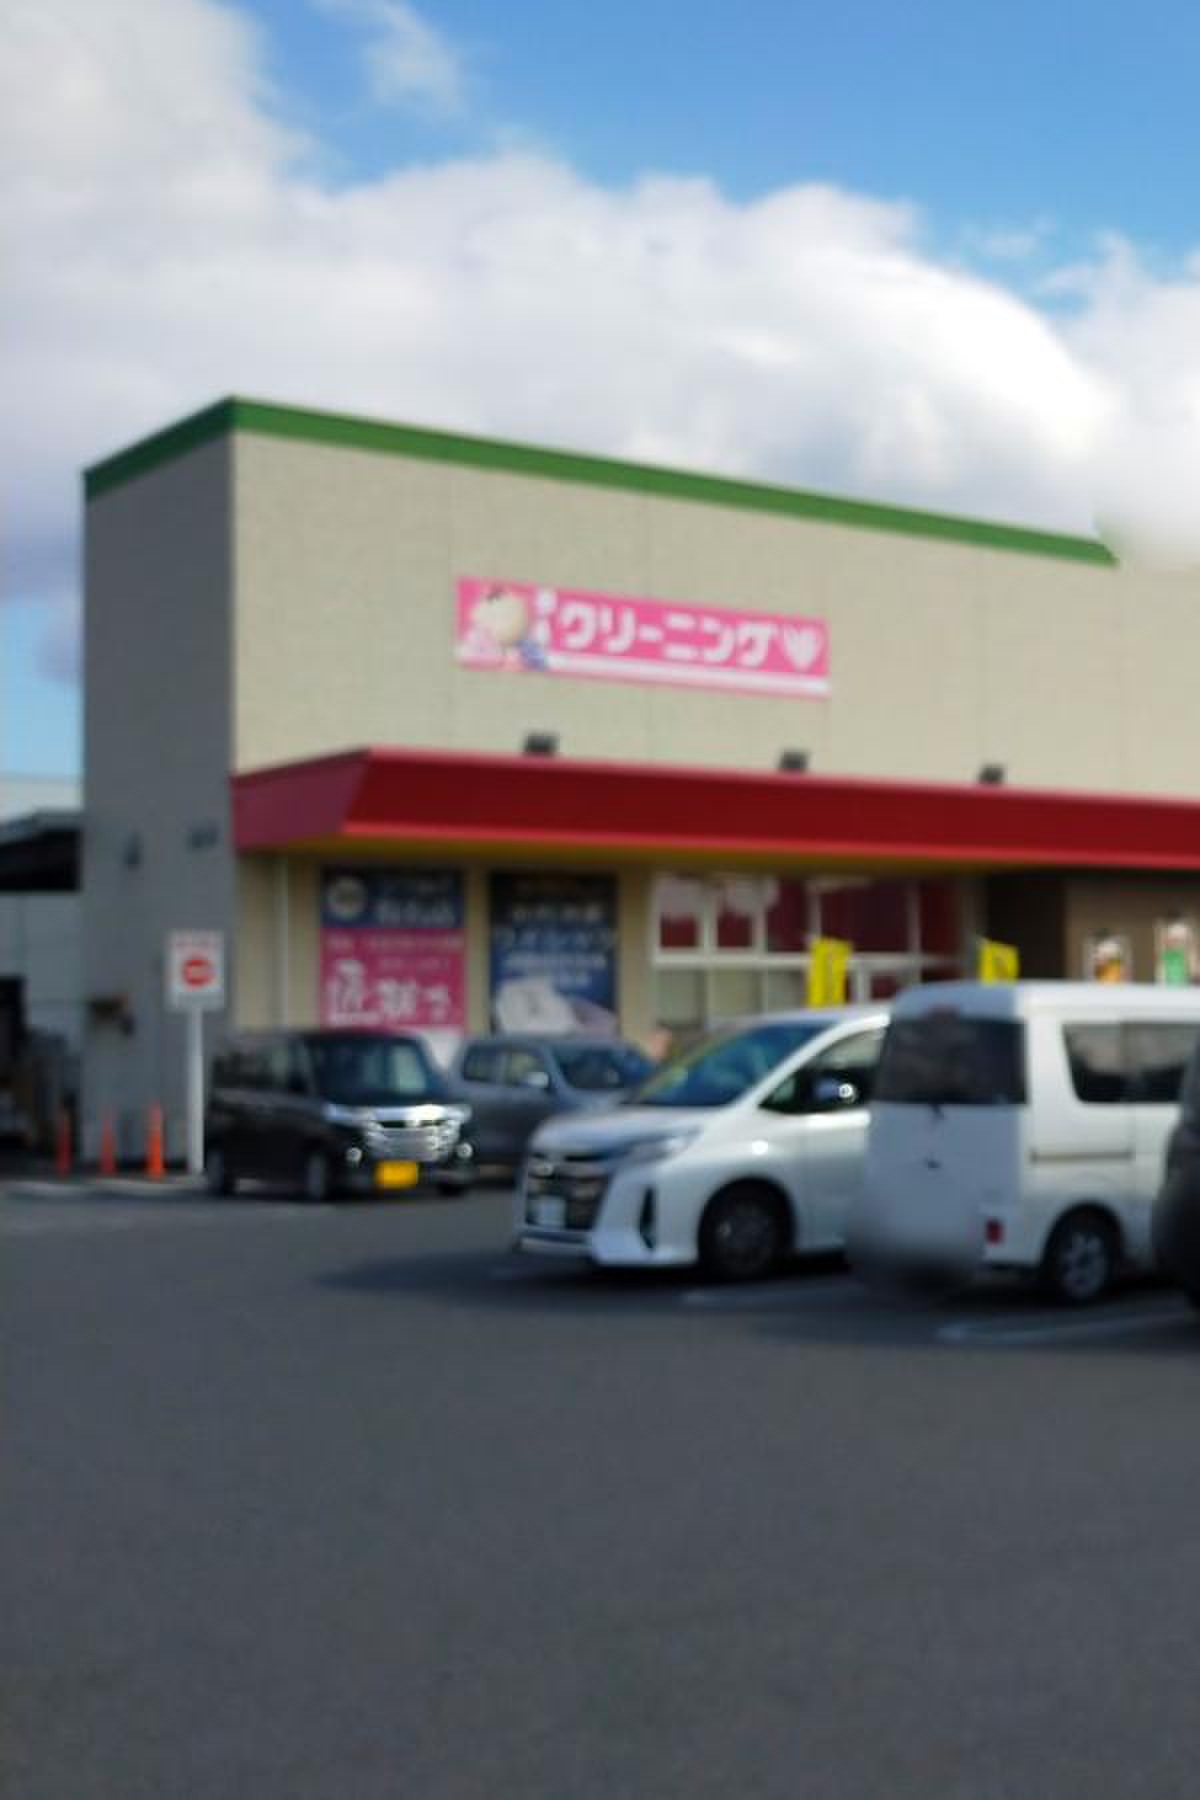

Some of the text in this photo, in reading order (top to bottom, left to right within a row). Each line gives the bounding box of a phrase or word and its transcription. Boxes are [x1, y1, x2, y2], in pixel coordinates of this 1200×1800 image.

[558, 602, 779, 668] クリーニング
